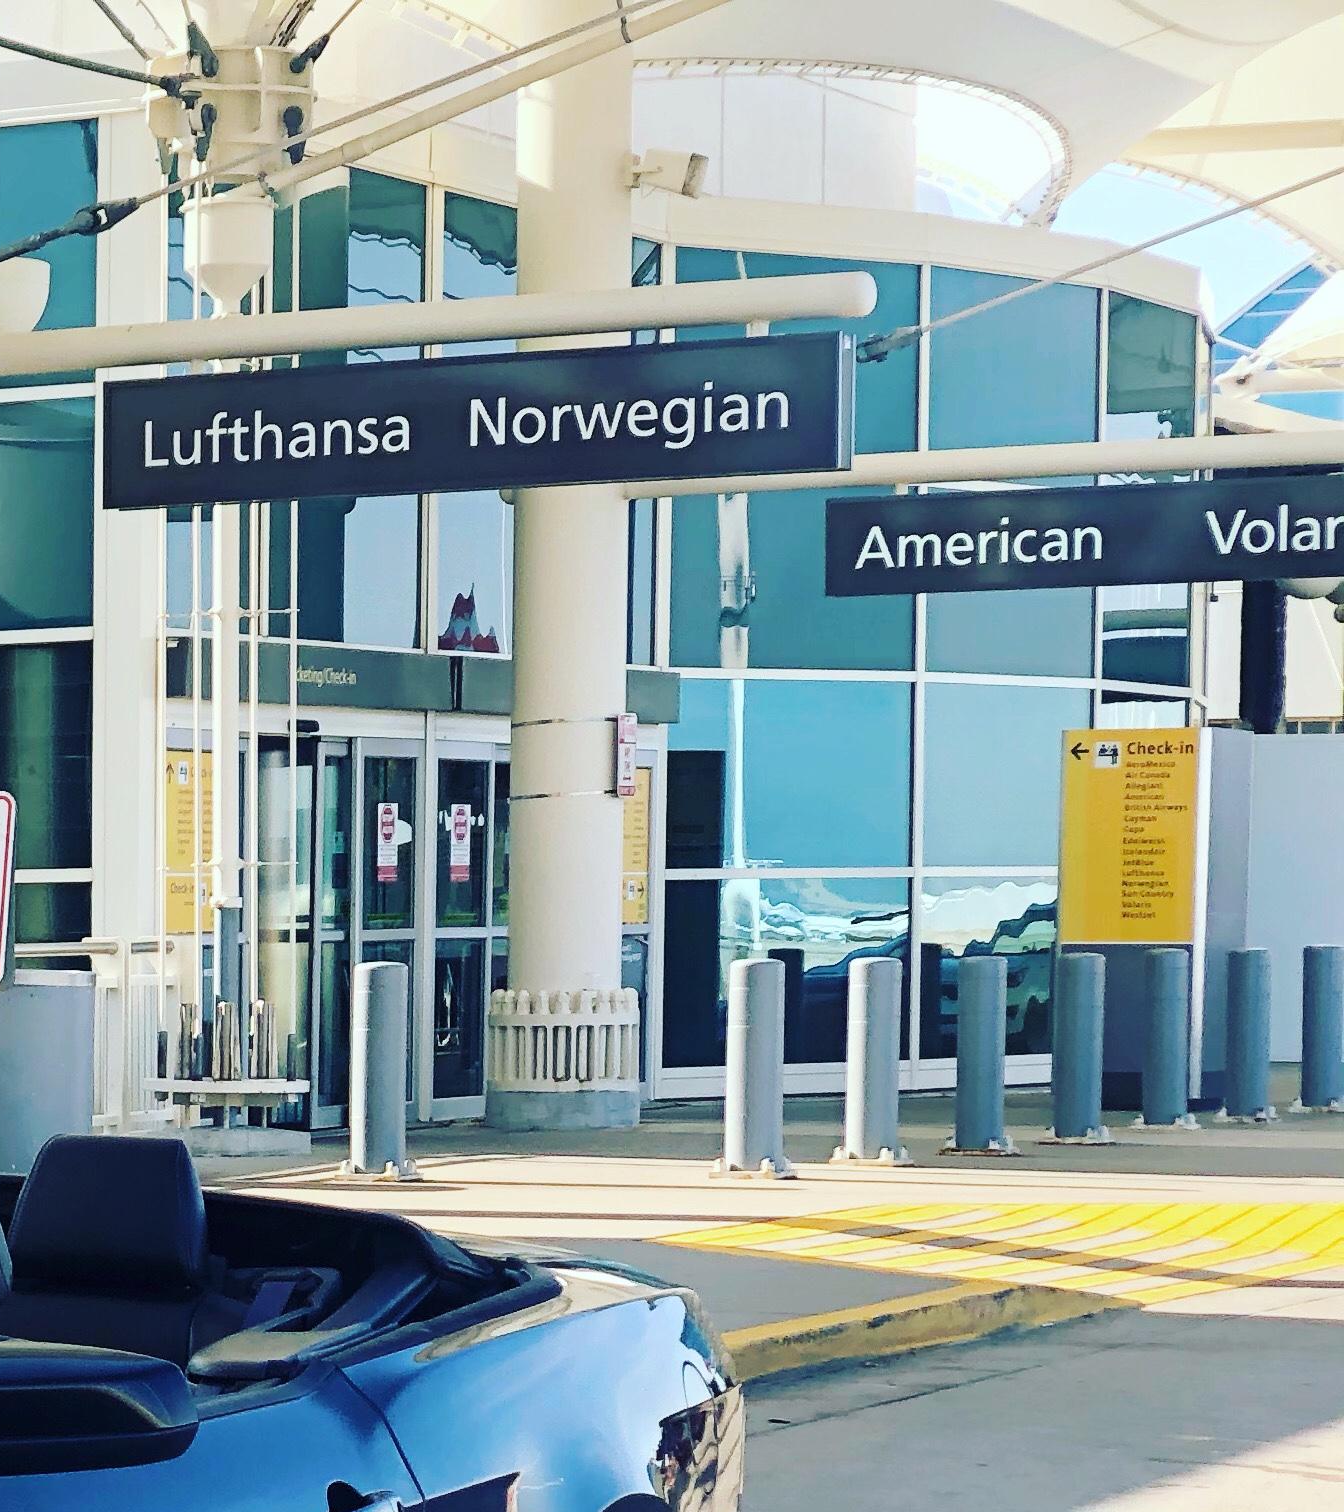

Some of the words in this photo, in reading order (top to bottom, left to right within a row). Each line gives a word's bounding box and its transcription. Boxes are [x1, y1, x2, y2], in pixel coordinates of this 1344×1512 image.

[144, 409, 411, 467] Lufthansa
[468, 382, 790, 450] Norwegian
[855, 517, 1103, 570] American
[1127, 740, 1194, 755] Check-in
[1126, 782, 1163, 791] Allegiant
[1155, 804, 1188, 813] Airways
